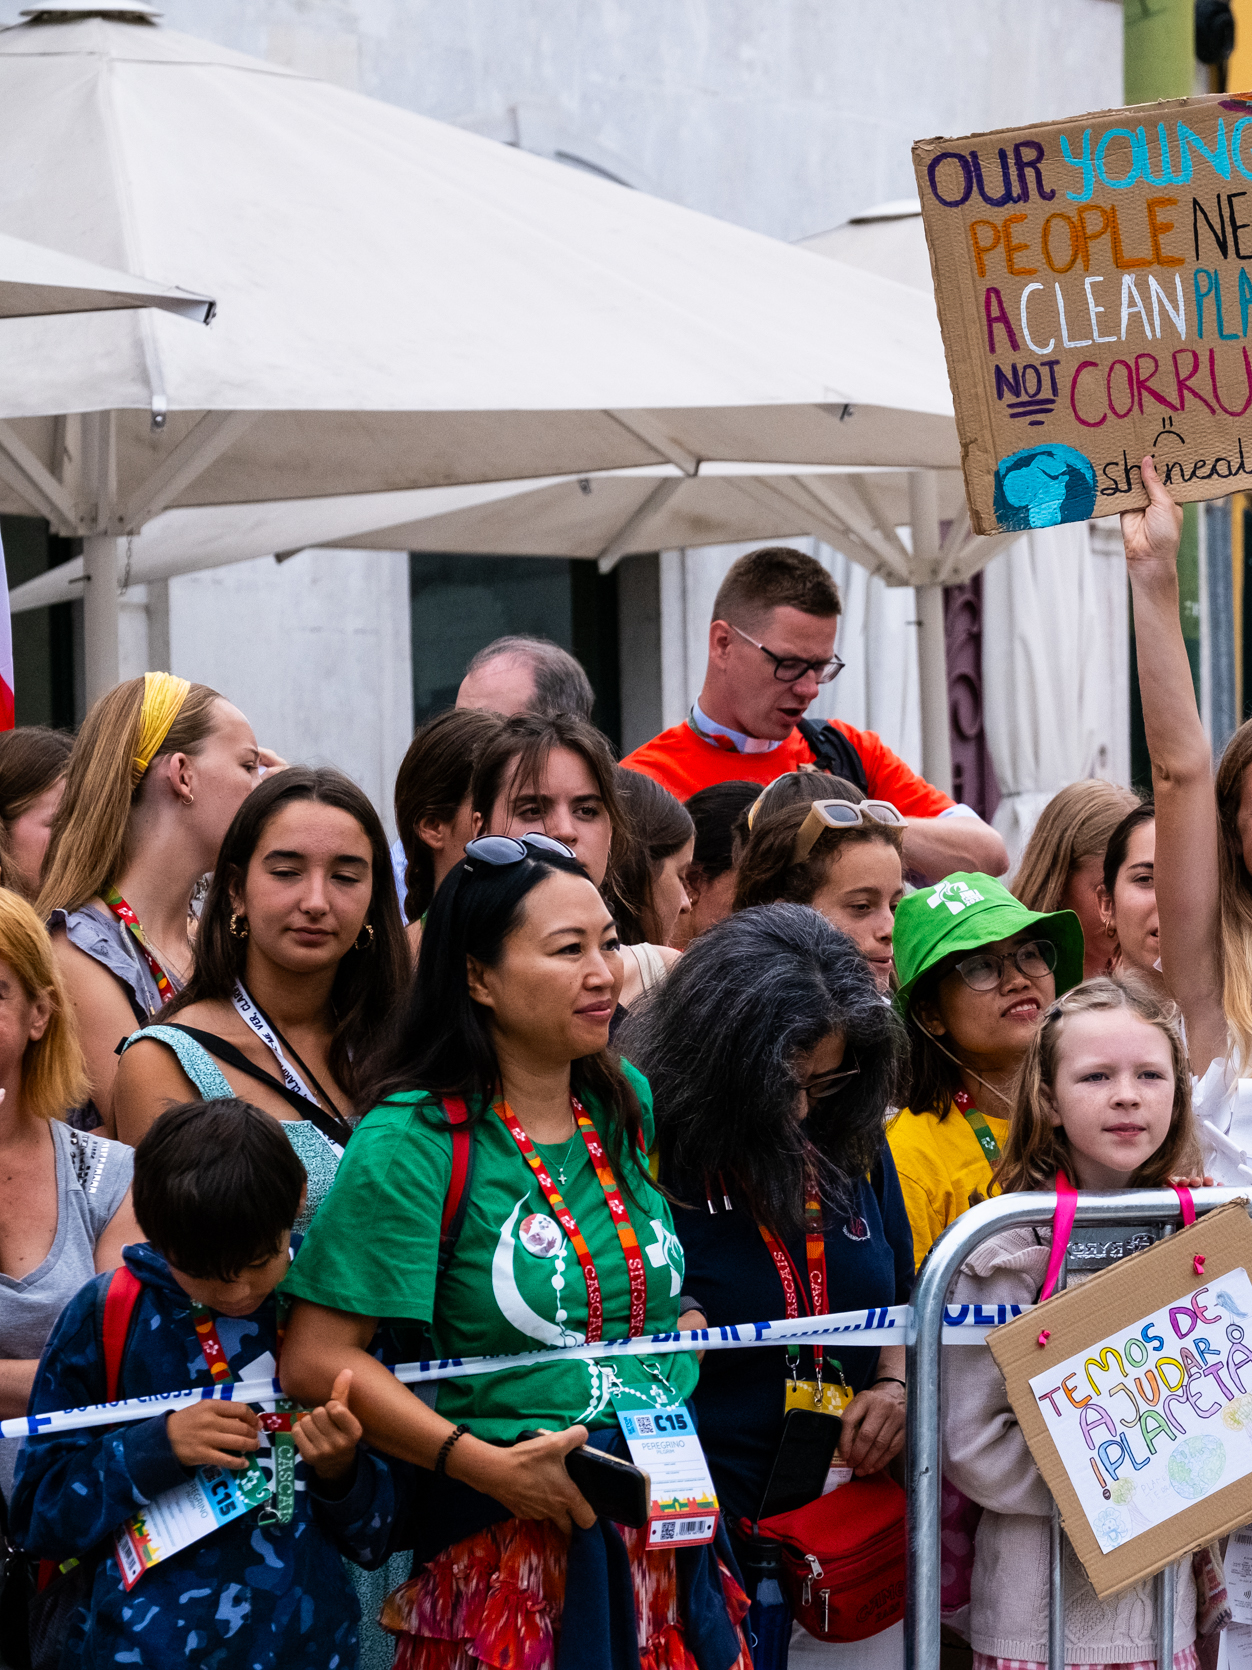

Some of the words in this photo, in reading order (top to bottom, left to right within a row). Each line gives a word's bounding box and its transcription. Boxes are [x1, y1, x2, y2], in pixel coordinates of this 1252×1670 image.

[927, 140, 1056, 207] OUR
[969, 197, 1186, 278] PEOPLE
[984, 286, 1020, 354] A
[1021, 273, 1186, 355] CLEAN
[994, 359, 1060, 400] NOT
[249, 1012, 264, 1031] VER,
[773, 1251, 799, 1319] ASCAIS
[1038, 1322, 1165, 1418] TEMOS
[1168, 1287, 1222, 1340] DE
[653, 1413, 688, 1432] C15
[1078, 1337, 1222, 1451] AJUDAR
[641, 1439, 686, 1450] PEREGRINO
[210, 1480, 238, 1517] C15
[277, 1445, 293, 1525] CASCAIS
